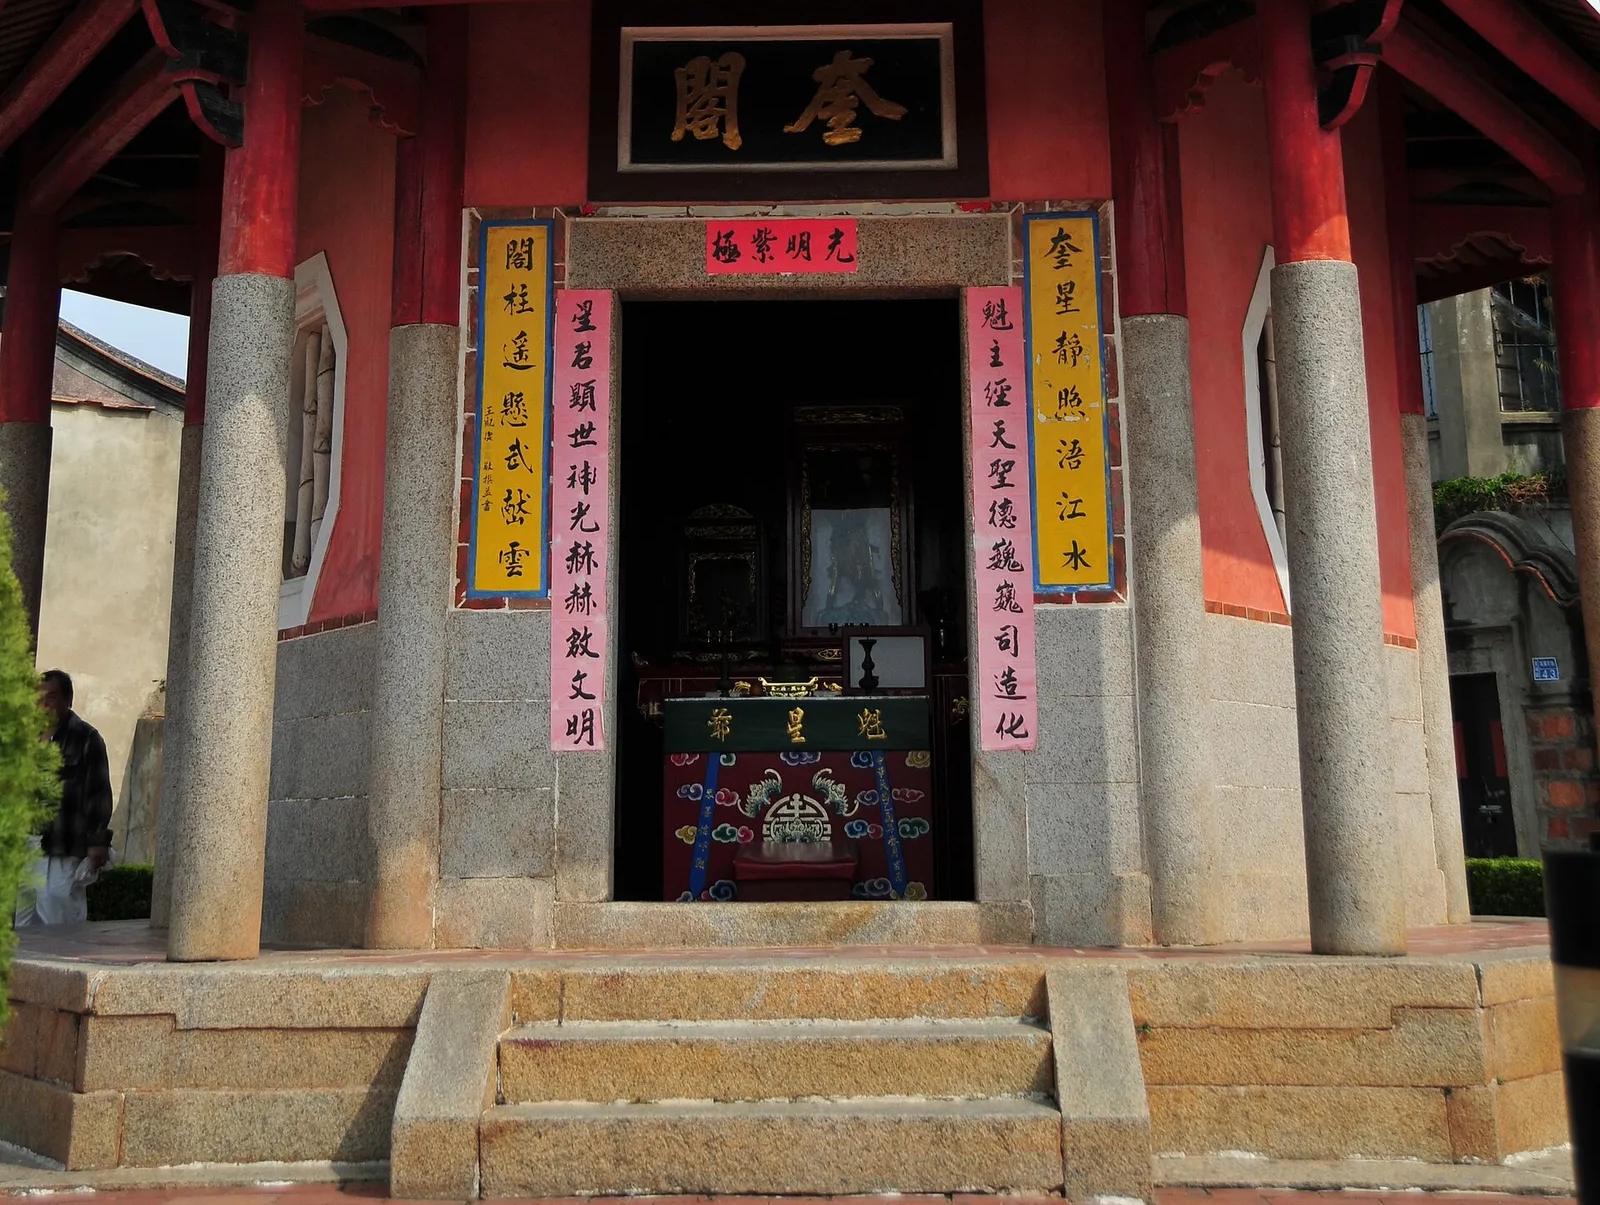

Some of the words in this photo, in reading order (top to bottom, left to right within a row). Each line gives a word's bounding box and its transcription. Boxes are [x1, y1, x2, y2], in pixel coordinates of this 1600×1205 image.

[670, 50, 908, 151] 奎閣
[712, 227, 854, 264] 光明紫極
